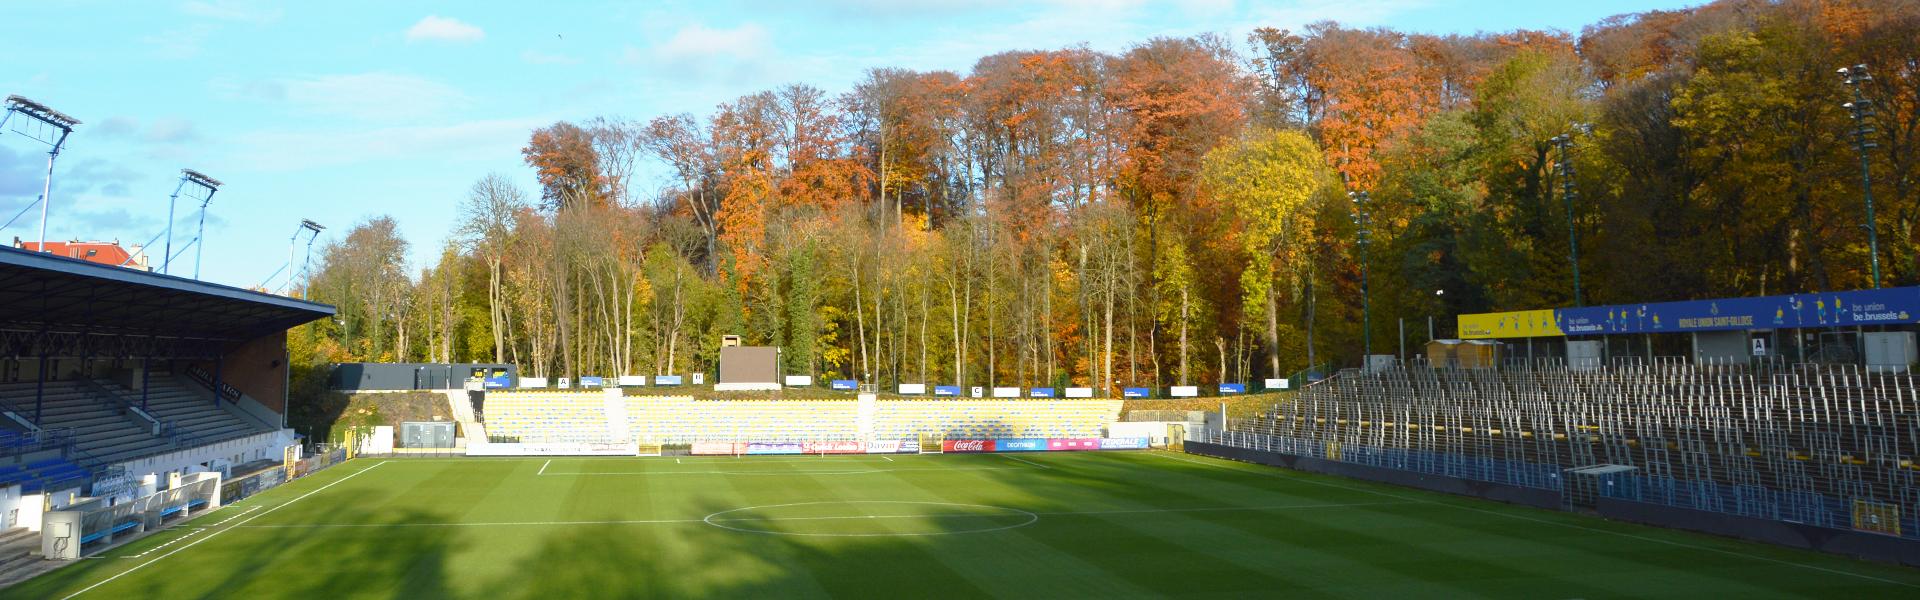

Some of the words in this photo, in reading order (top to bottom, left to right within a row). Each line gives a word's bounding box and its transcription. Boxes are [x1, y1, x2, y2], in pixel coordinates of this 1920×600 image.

[1864, 302, 1885, 311] union
[1853, 311, 1897, 321] be.brussels
[1755, 339, 1762, 349] A
